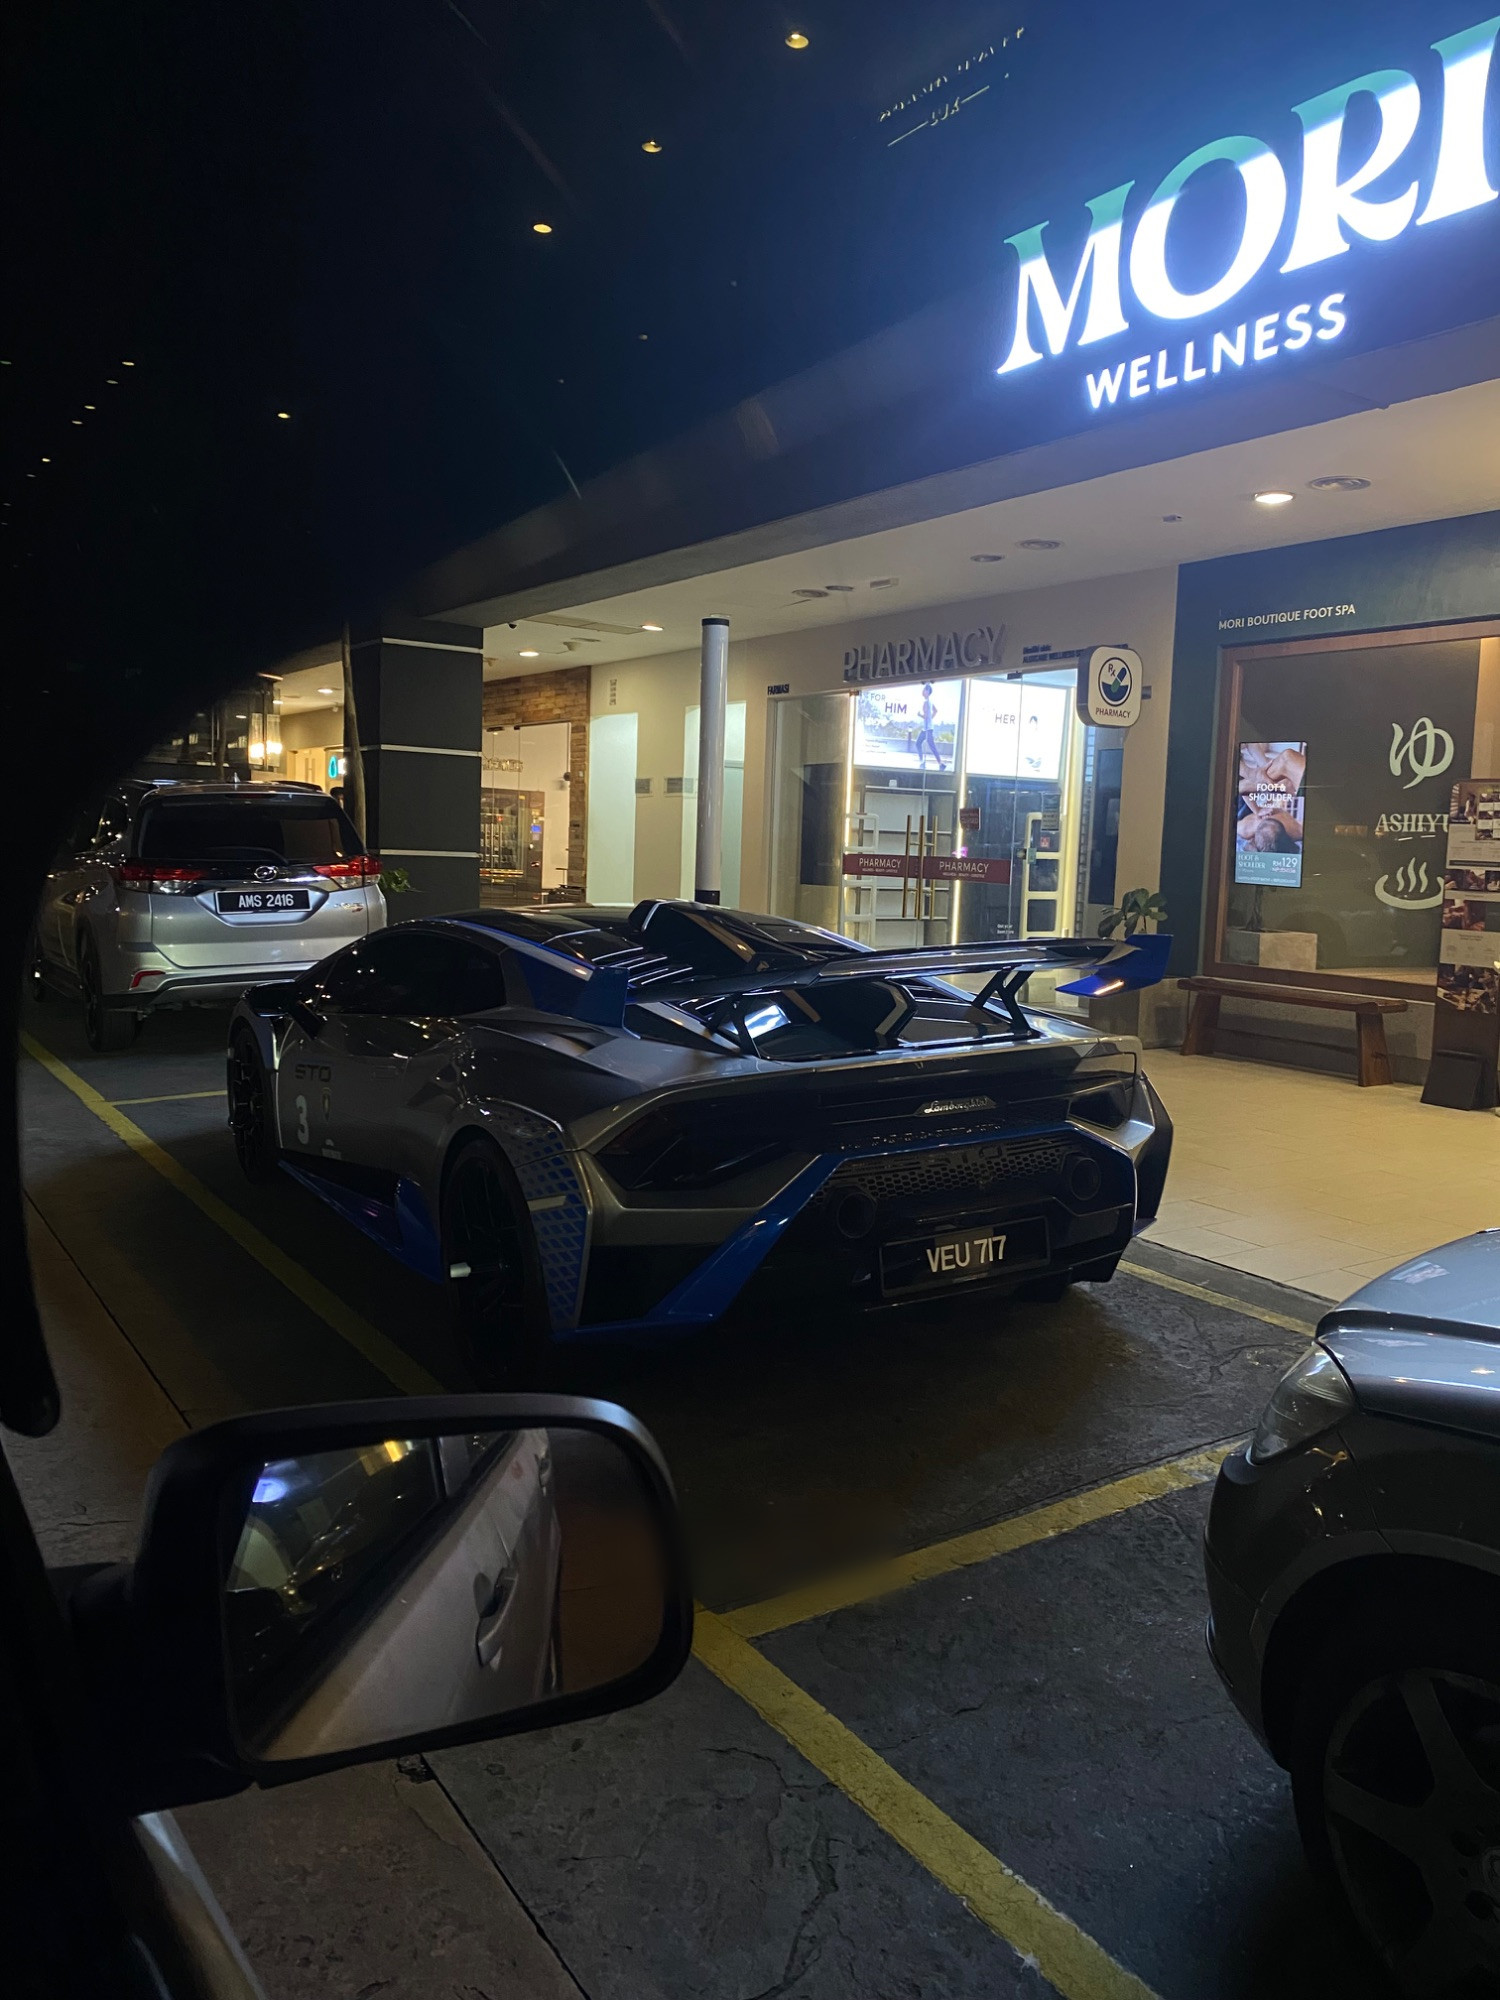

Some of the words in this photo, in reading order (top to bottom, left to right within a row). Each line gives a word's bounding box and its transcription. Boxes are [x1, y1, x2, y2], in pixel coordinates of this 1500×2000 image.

[997, 15, 1500, 375] MORI
[1085, 292, 1347, 410] WELLNESS
[1218, 617, 1245, 631] MORI
[1247, 610, 1301, 627] BOUTIQUE
[1303, 606, 1334, 620] FOOT
[1334, 603, 1356, 616] SPA
[843, 623, 1005, 682] PHARMACY
[870, 692, 886, 701] FOR
[884, 702, 907, 714] HIM
[1095, 706, 1132, 720] PHARMACY
[994, 713, 1016, 724] HER
[1256, 783, 1279, 792] FOOT
[1248, 792, 1293, 802] SHOULDER
[859, 857, 902, 869] PHARMACY
[938, 861, 989, 873] PHARMACY
[238, 894, 263, 909] AMS
[266, 893, 294, 907] 2416
[295, 1064, 331, 1082] STO
[926, 1240, 971, 1273] VEU
[975, 1234, 1007, 1265] 717
